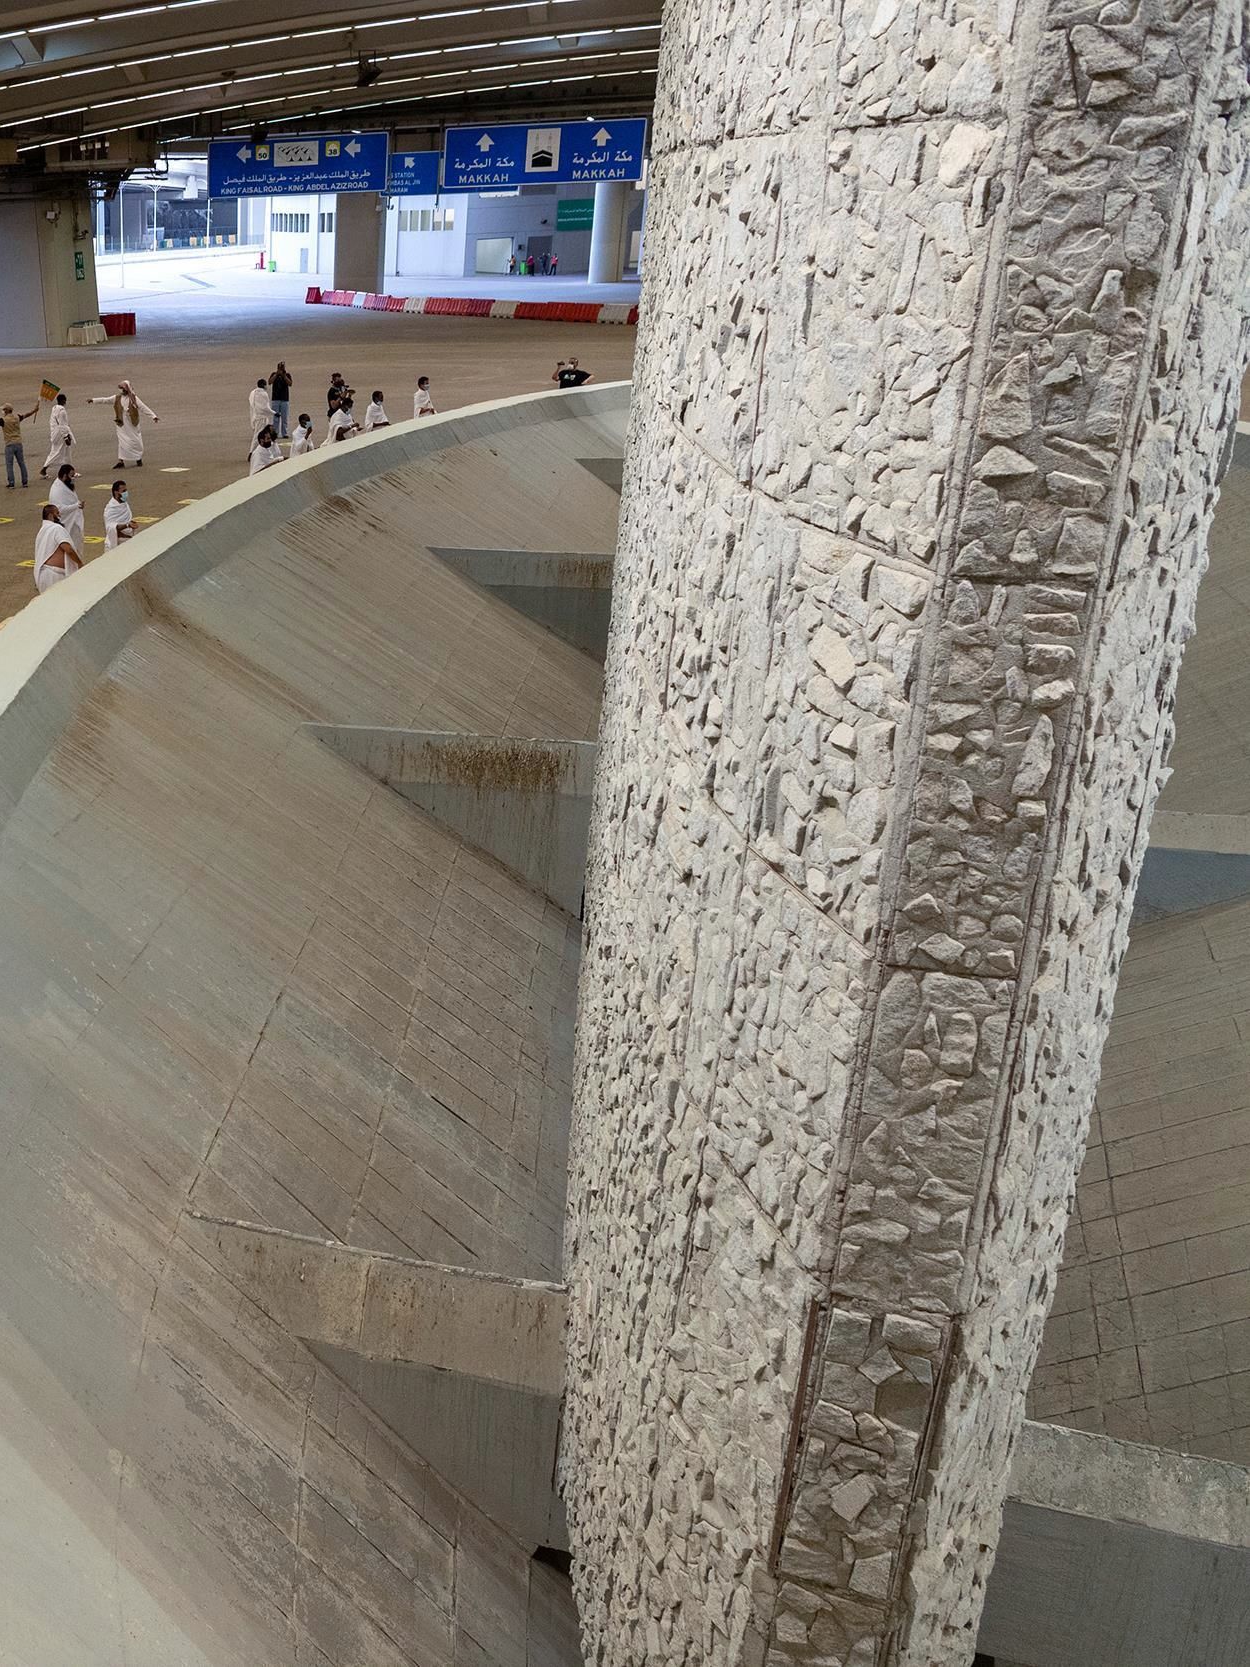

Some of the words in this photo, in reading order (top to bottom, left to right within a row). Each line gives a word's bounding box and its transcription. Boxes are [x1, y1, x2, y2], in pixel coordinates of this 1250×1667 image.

[572, 151, 610, 166] المكرمة
[614, 151, 633, 162] مكة
[454, 158, 491, 171] المكرمة
[496, 157, 515, 167] مكة
[246, 174, 267, 182] الملك
[266, 173, 287, 183] طريق
[329, 170, 350, 179] الملك
[350, 169, 371, 179] طريق
[572, 167, 625, 179] MAKKAH
[223, 174, 246, 185] فيصل
[458, 173, 509, 184] MAKKAH
[348, 181, 369, 189] ROAD
